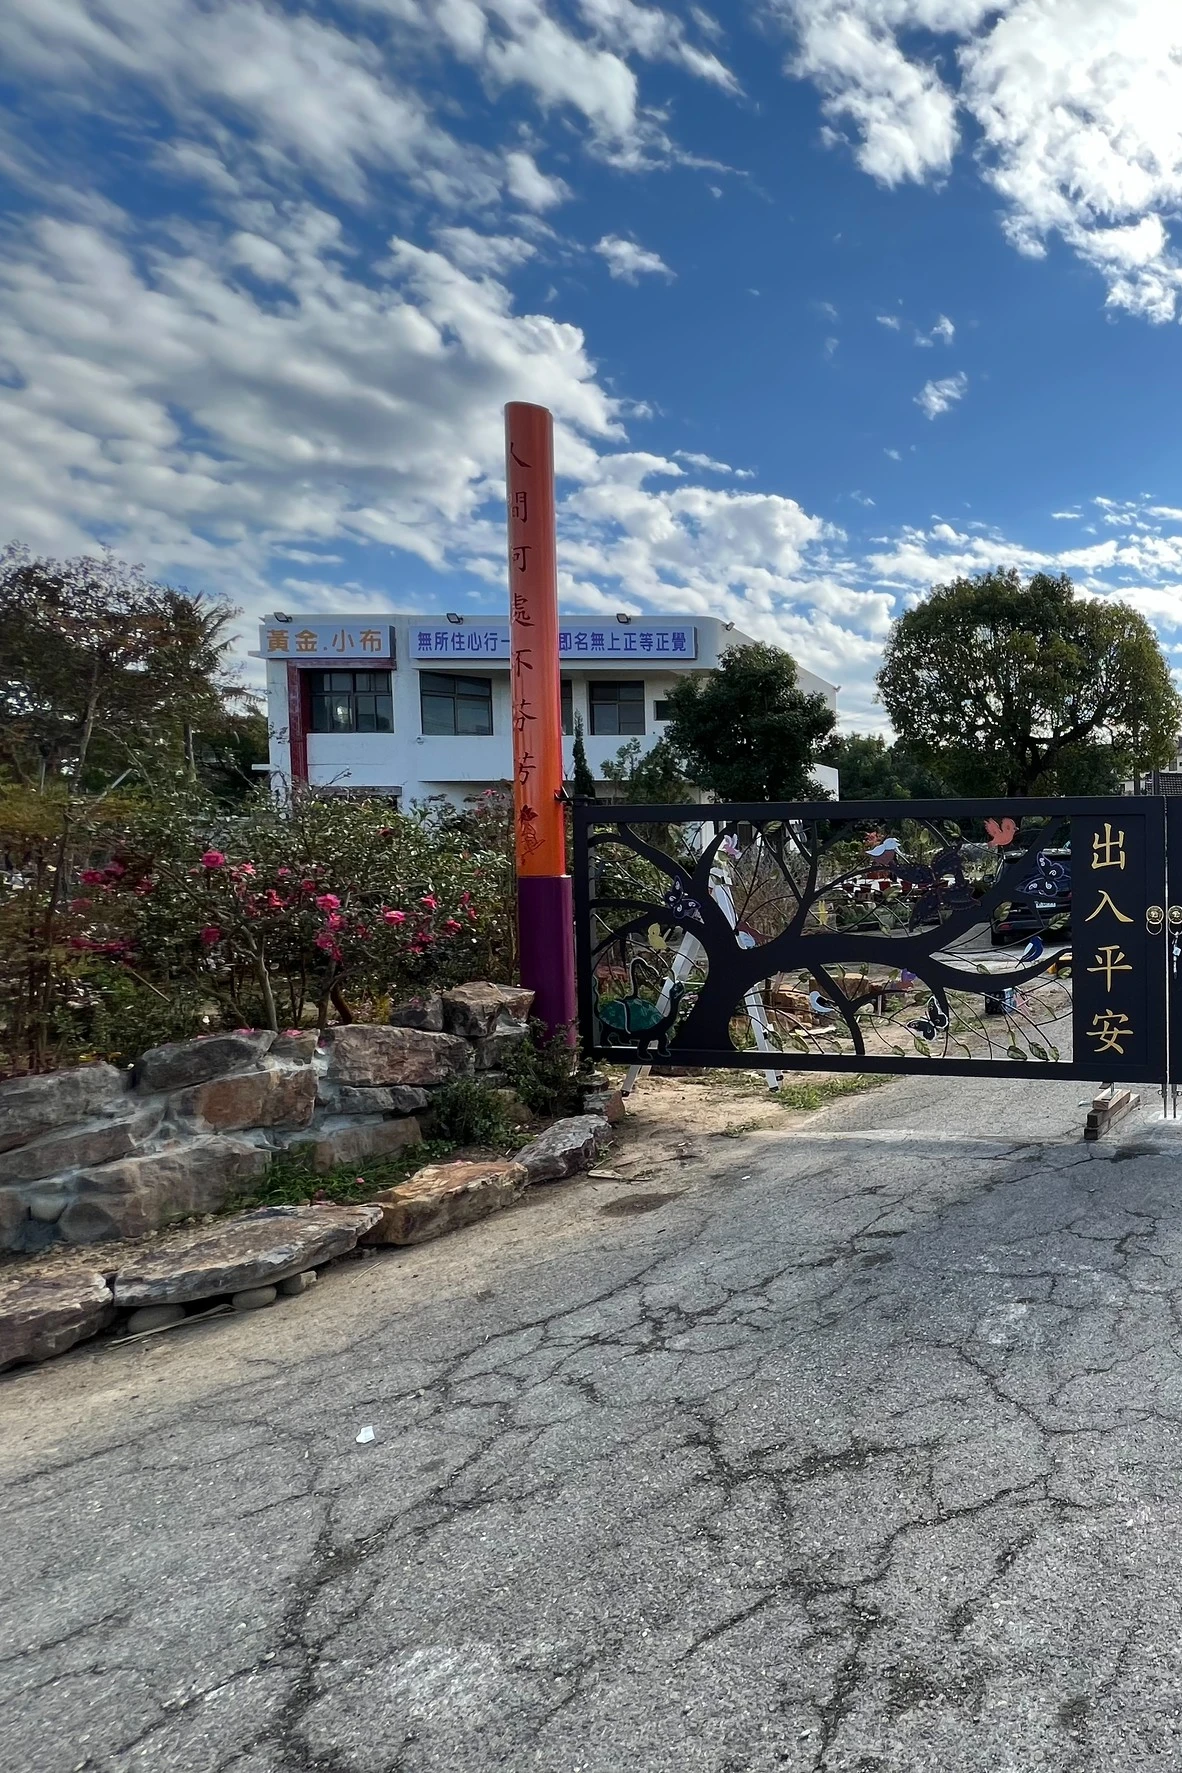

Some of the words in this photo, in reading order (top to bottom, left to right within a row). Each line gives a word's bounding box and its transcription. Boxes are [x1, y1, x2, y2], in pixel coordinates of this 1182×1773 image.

[417, 630, 688, 652] 無所住心行一即名無上正等正覺
[1084, 822, 1135, 1055] 出入平安
